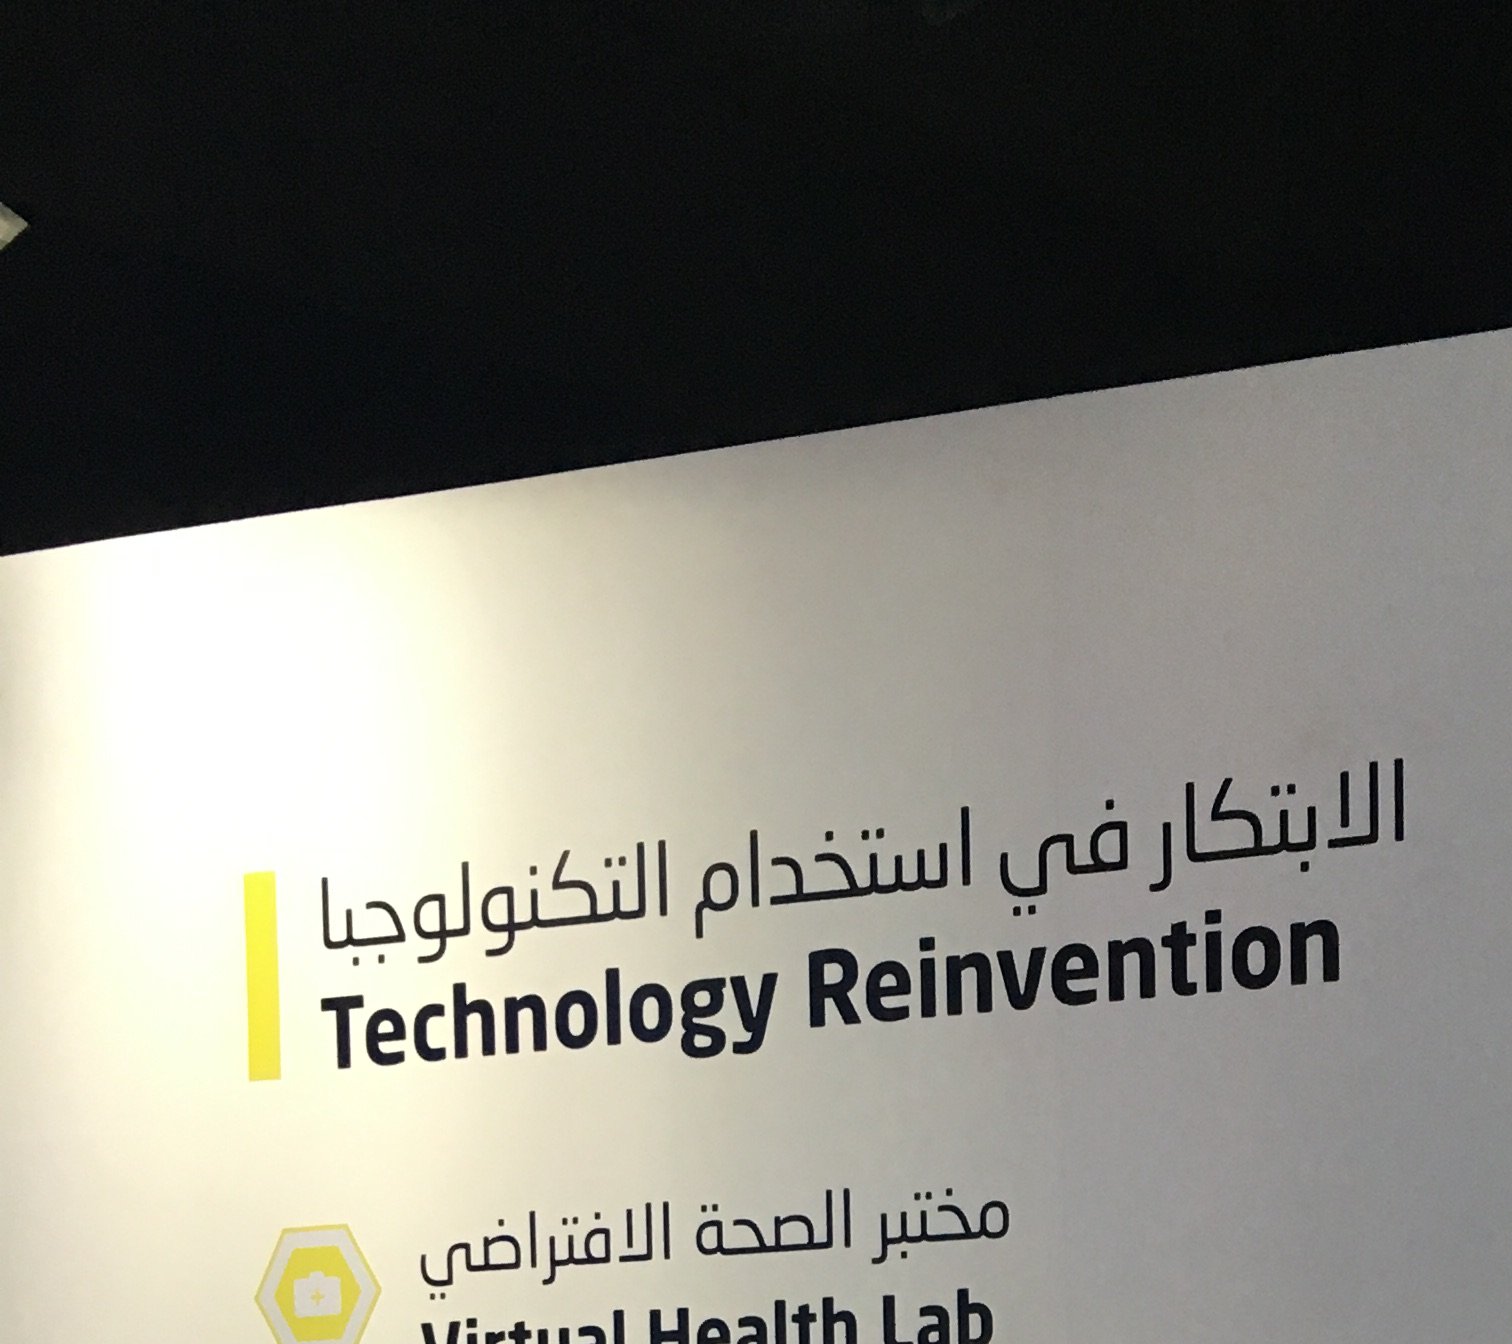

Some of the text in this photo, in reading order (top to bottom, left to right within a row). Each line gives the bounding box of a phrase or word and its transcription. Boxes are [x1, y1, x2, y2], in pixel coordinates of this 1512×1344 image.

[695, 806, 971, 939] استخدام
[1000, 799, 1128, 916] في
[1149, 758, 1404, 892] الابتكار
[321, 909, 1340, 1069] Technology Reinvention
[421, 1188, 1009, 1300] مختبر الصحة الافتراضي
